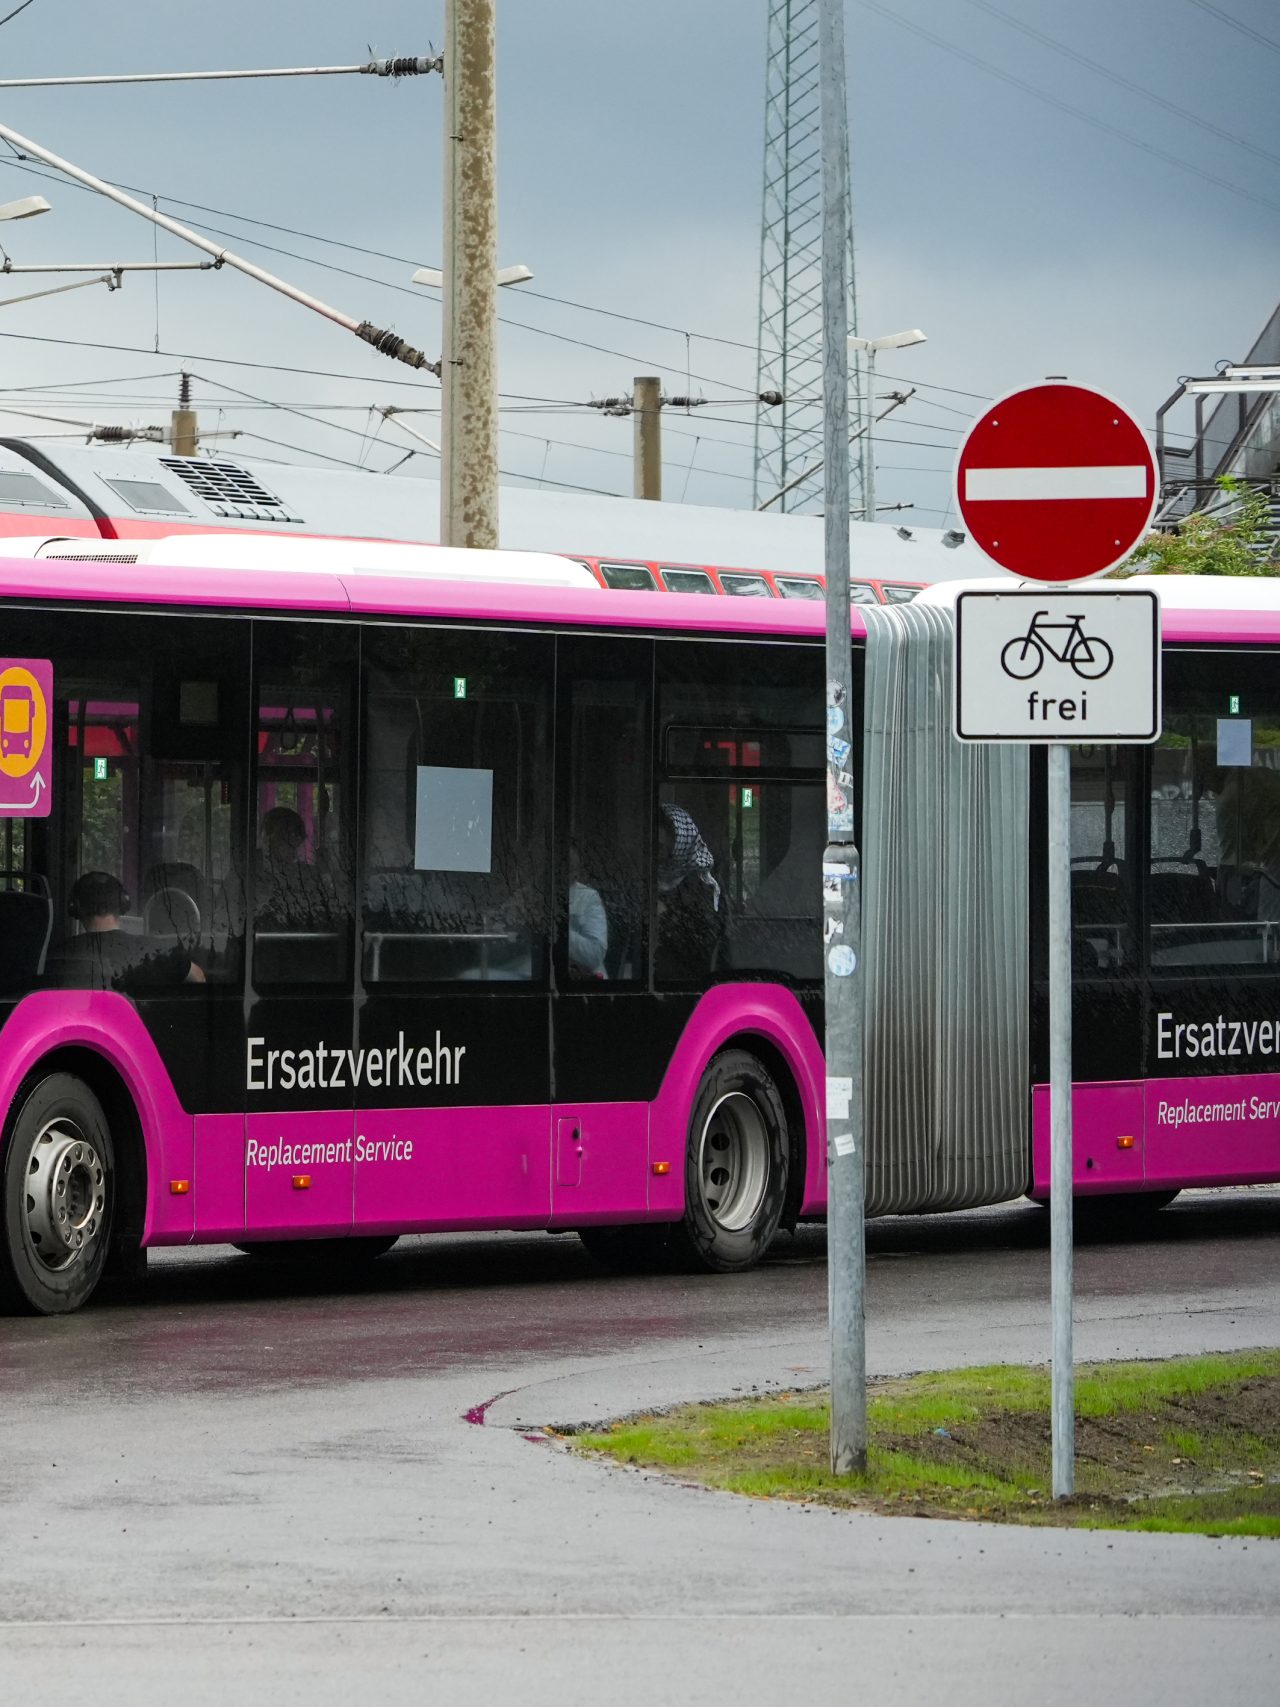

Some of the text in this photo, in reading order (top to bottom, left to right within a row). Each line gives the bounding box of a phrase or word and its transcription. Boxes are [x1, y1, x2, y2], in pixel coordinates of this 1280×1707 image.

[1027, 690, 1087, 721] frei
[246, 1029, 467, 1090] Ersatzverkehr
[1157, 1098, 1247, 1129] Replacement
[246, 1134, 414, 1172] Replacement Service
